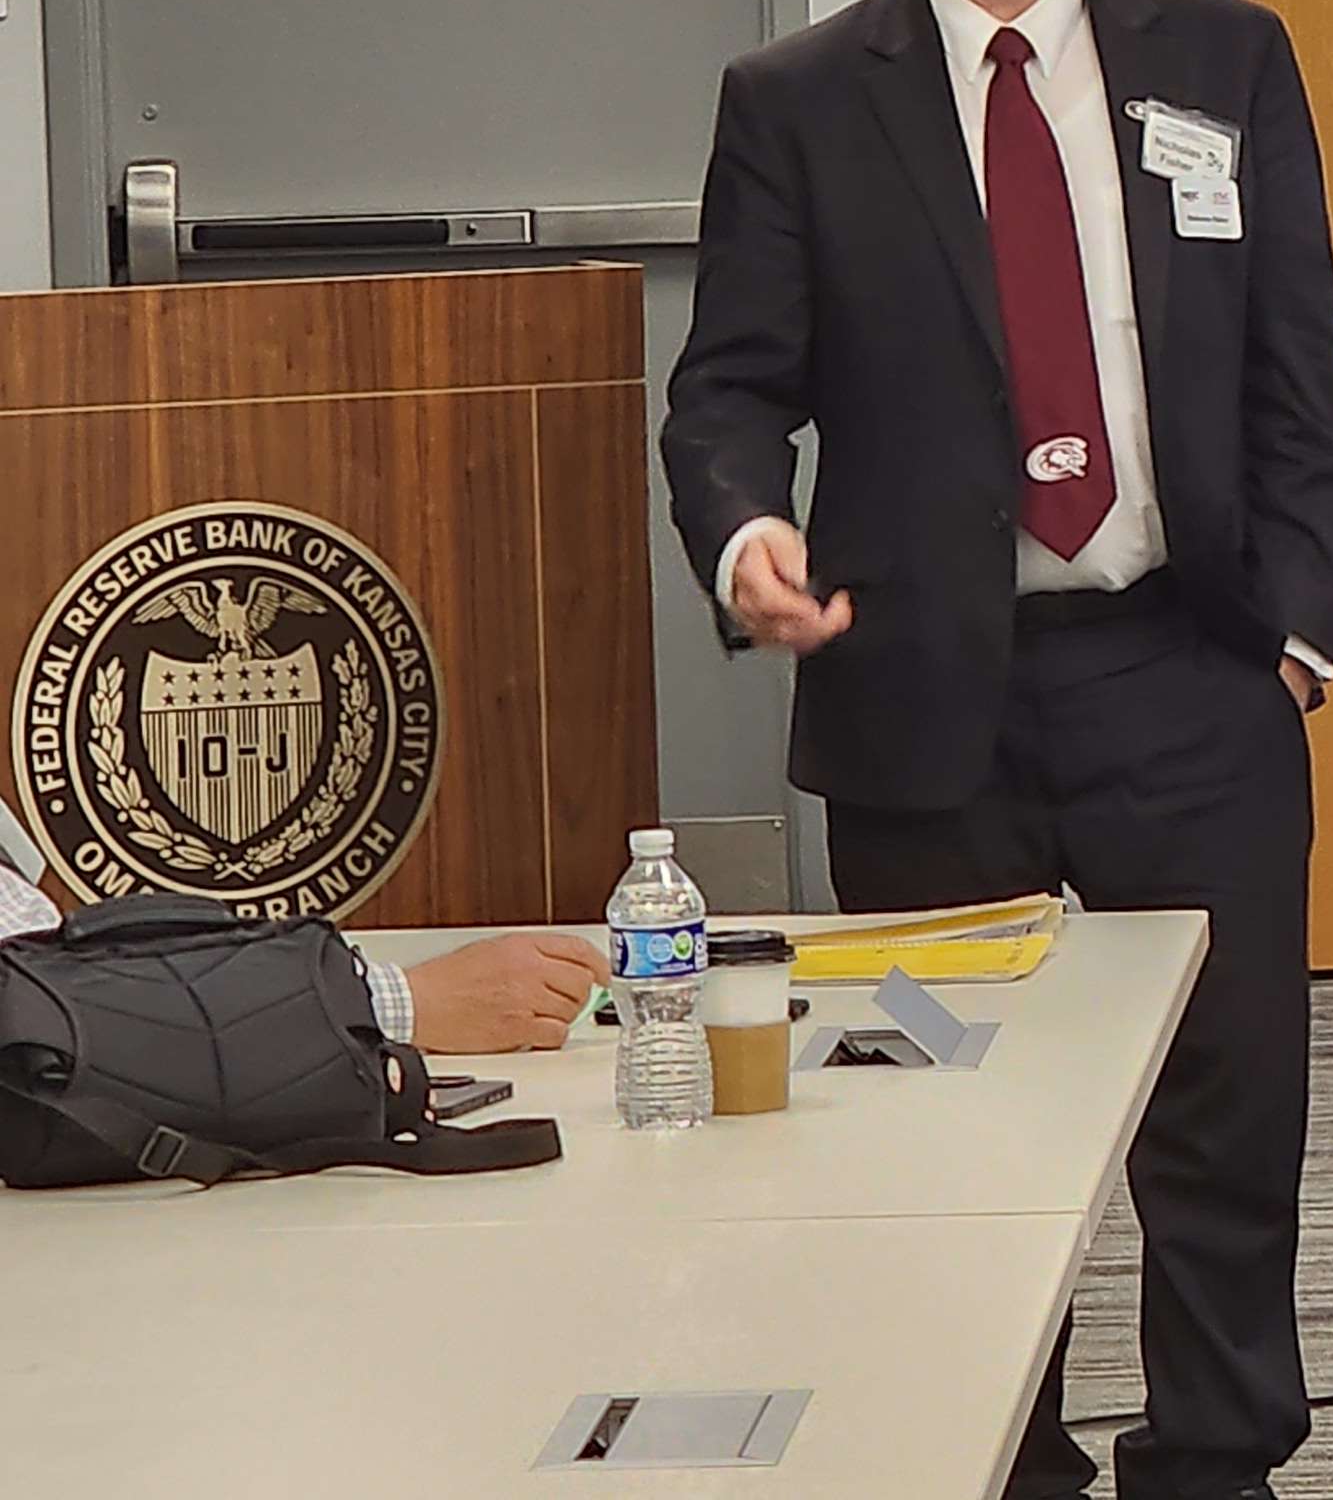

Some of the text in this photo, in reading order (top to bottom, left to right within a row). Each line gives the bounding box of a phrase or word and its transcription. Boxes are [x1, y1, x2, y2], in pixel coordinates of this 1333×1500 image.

[30, 519, 430, 793] FEDERAL RESERVE BANK OF KANSAS CITY
